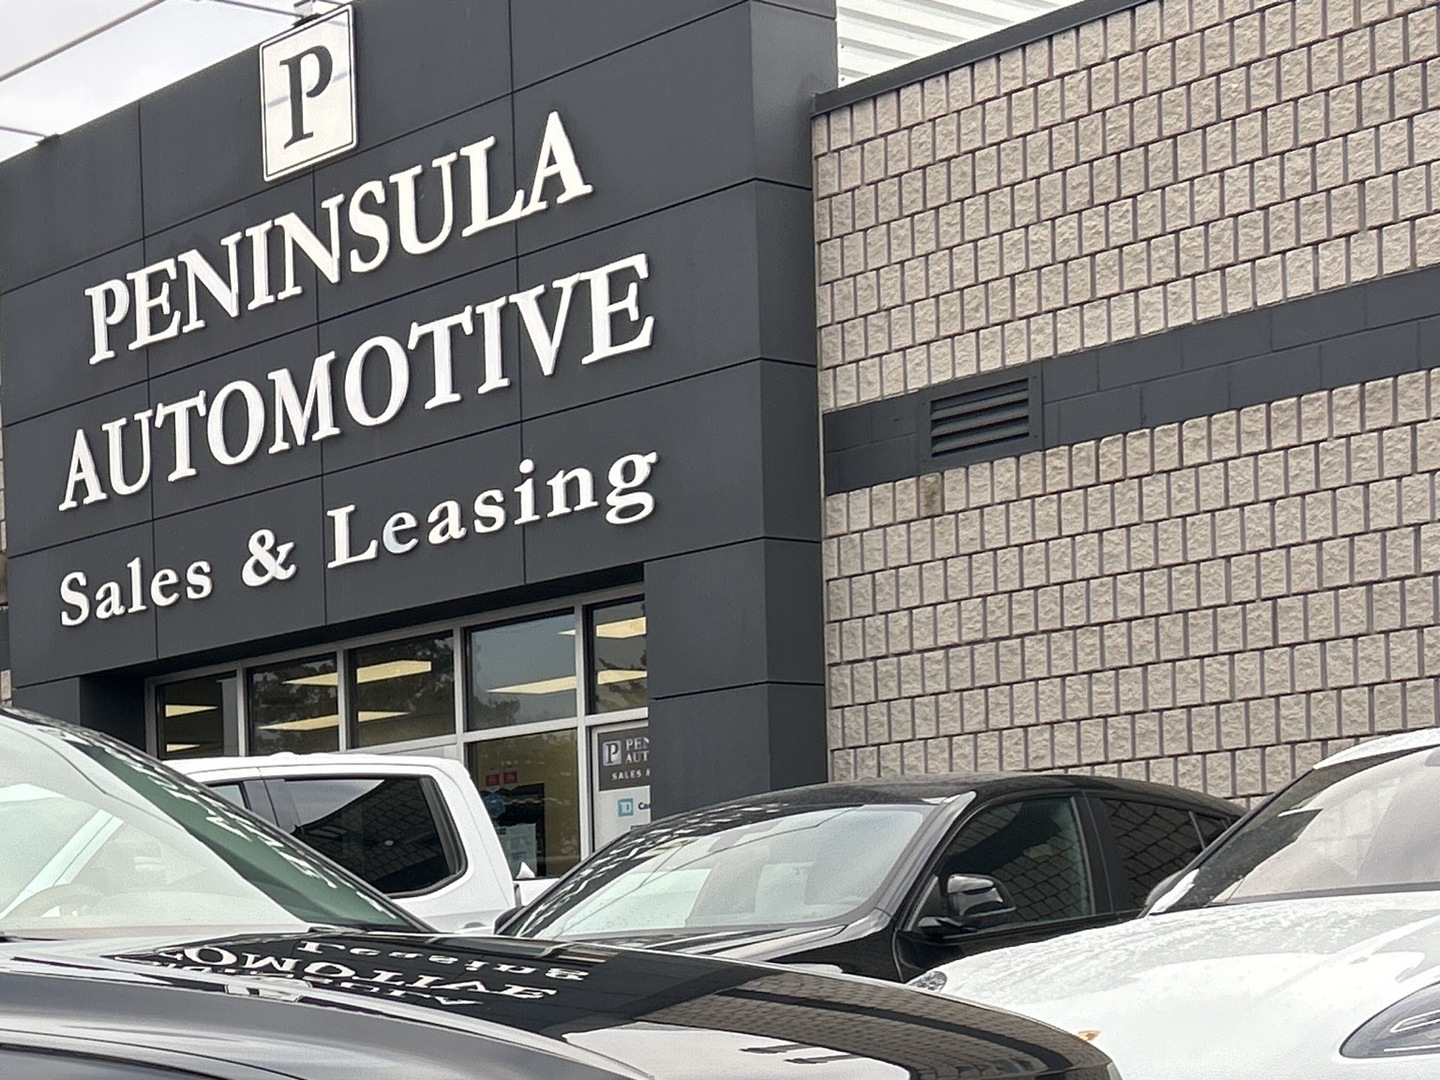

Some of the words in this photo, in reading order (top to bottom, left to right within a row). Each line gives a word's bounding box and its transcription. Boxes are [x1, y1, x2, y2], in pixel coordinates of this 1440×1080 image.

[278, 44, 334, 150] P
[84, 111, 594, 367] PENINSULA
[58, 253, 657, 512] AUTOMOTIVE
[61, 557, 214, 627] Sales
[241, 528, 297, 588] &
[326, 451, 658, 570] Leasing
[612, 769, 642, 781] SALES
